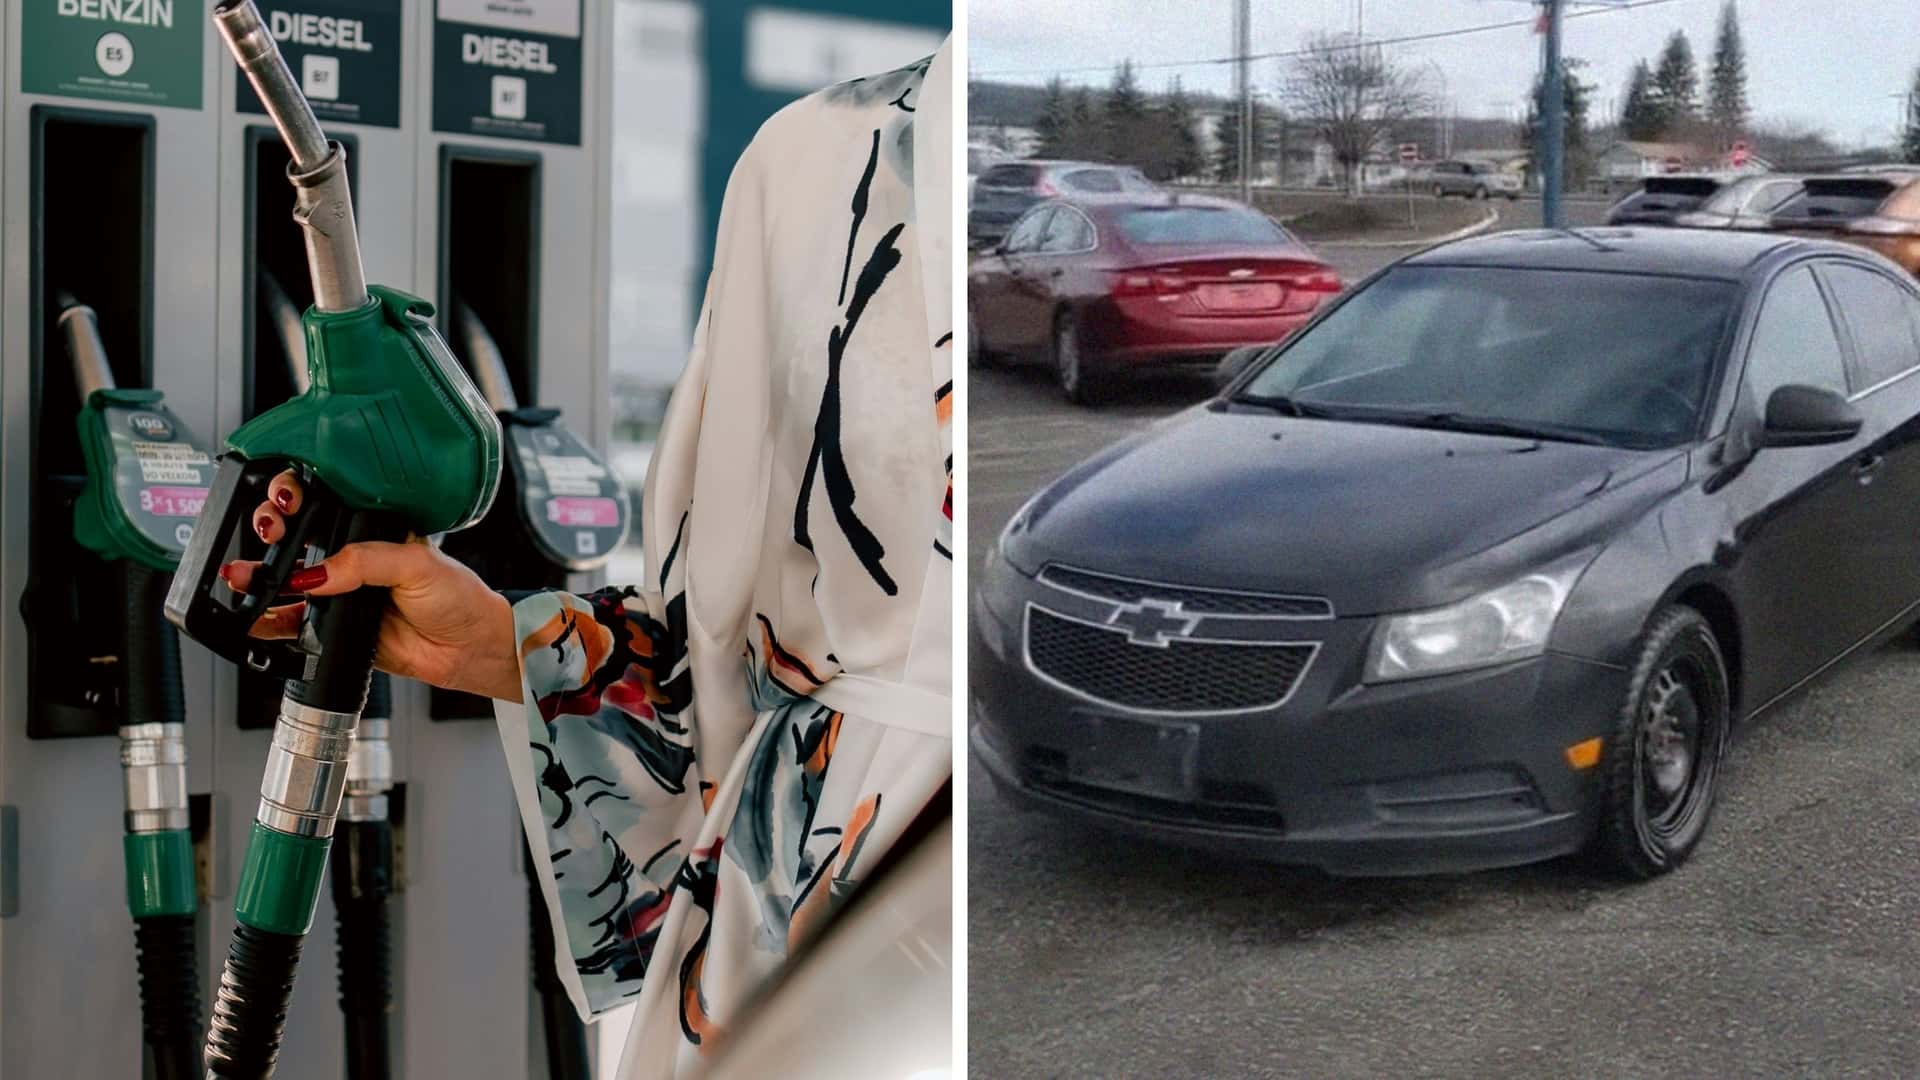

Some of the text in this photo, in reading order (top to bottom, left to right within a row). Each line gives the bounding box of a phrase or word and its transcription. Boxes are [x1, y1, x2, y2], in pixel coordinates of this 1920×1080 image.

[57, 0, 173, 28] BENZIN
[270, 10, 373, 52] DIESEL
[461, 32, 558, 75] DIESEL
